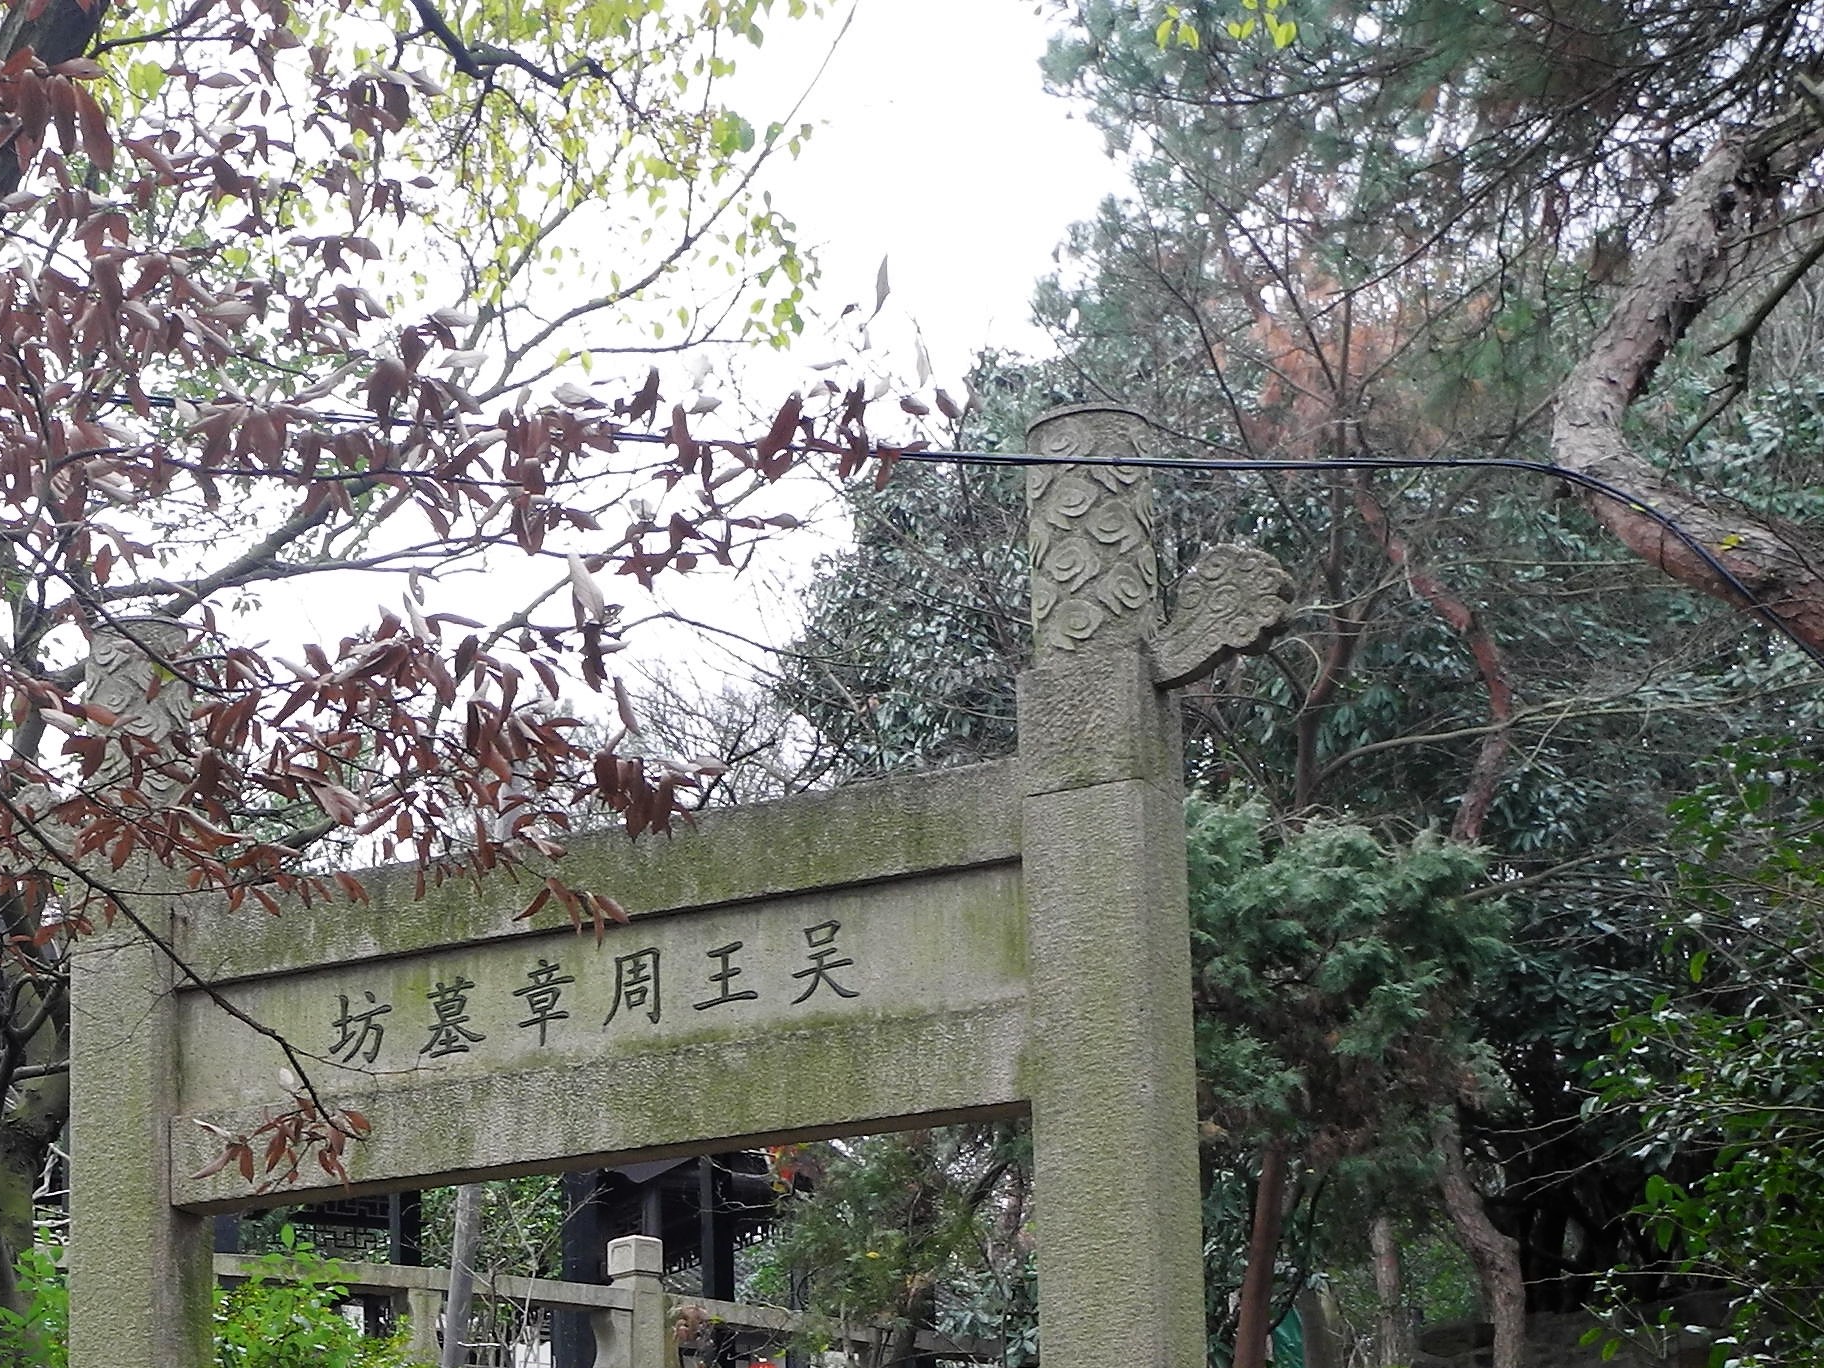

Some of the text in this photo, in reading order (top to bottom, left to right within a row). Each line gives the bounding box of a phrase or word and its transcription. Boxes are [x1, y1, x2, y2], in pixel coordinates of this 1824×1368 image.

[328, 919, 861, 1063] 吴王周章墓坊
